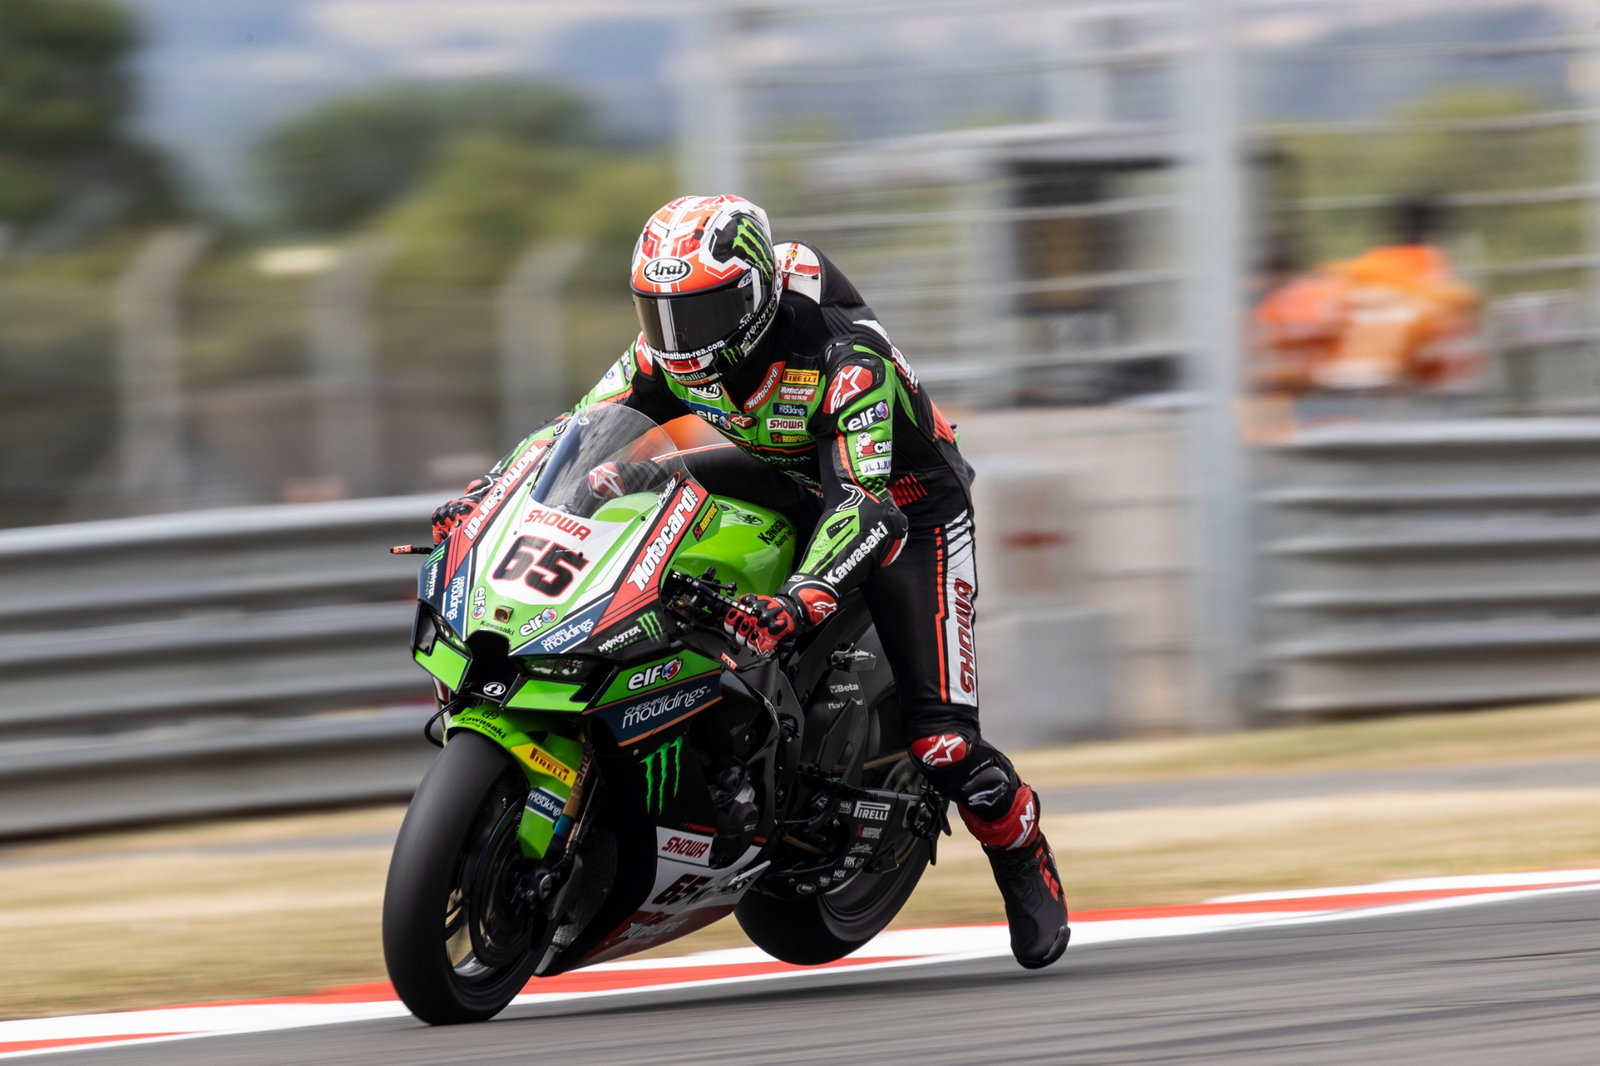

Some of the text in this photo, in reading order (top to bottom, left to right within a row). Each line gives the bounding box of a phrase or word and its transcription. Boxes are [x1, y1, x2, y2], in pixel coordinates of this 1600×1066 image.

[646, 261, 684, 276] Arai
[746, 366, 779, 408] Motocard
[784, 371, 817, 383] PIRELLI
[769, 420, 803, 429] SHOWA
[847, 407, 876, 432] elf
[525, 510, 591, 541] SHOWA
[823, 521, 889, 586] Kawasaki
[492, 535, 590, 598] 65
[480, 620, 515, 636] Kawasaki
[520, 614, 543, 637] elf
[954, 578, 975, 694] SHOWA
[598, 625, 642, 652] MONSTER
[628, 664, 663, 690] elf
[837, 683, 860, 693] Beta
[622, 686, 708, 729] mouldings
[459, 717, 508, 739] Kawasaki
[530, 747, 570, 781] PIRELLI
[853, 800, 892, 821] PIRELLI
[661, 836, 710, 858] SHOWA
[652, 873, 714, 905] 65
